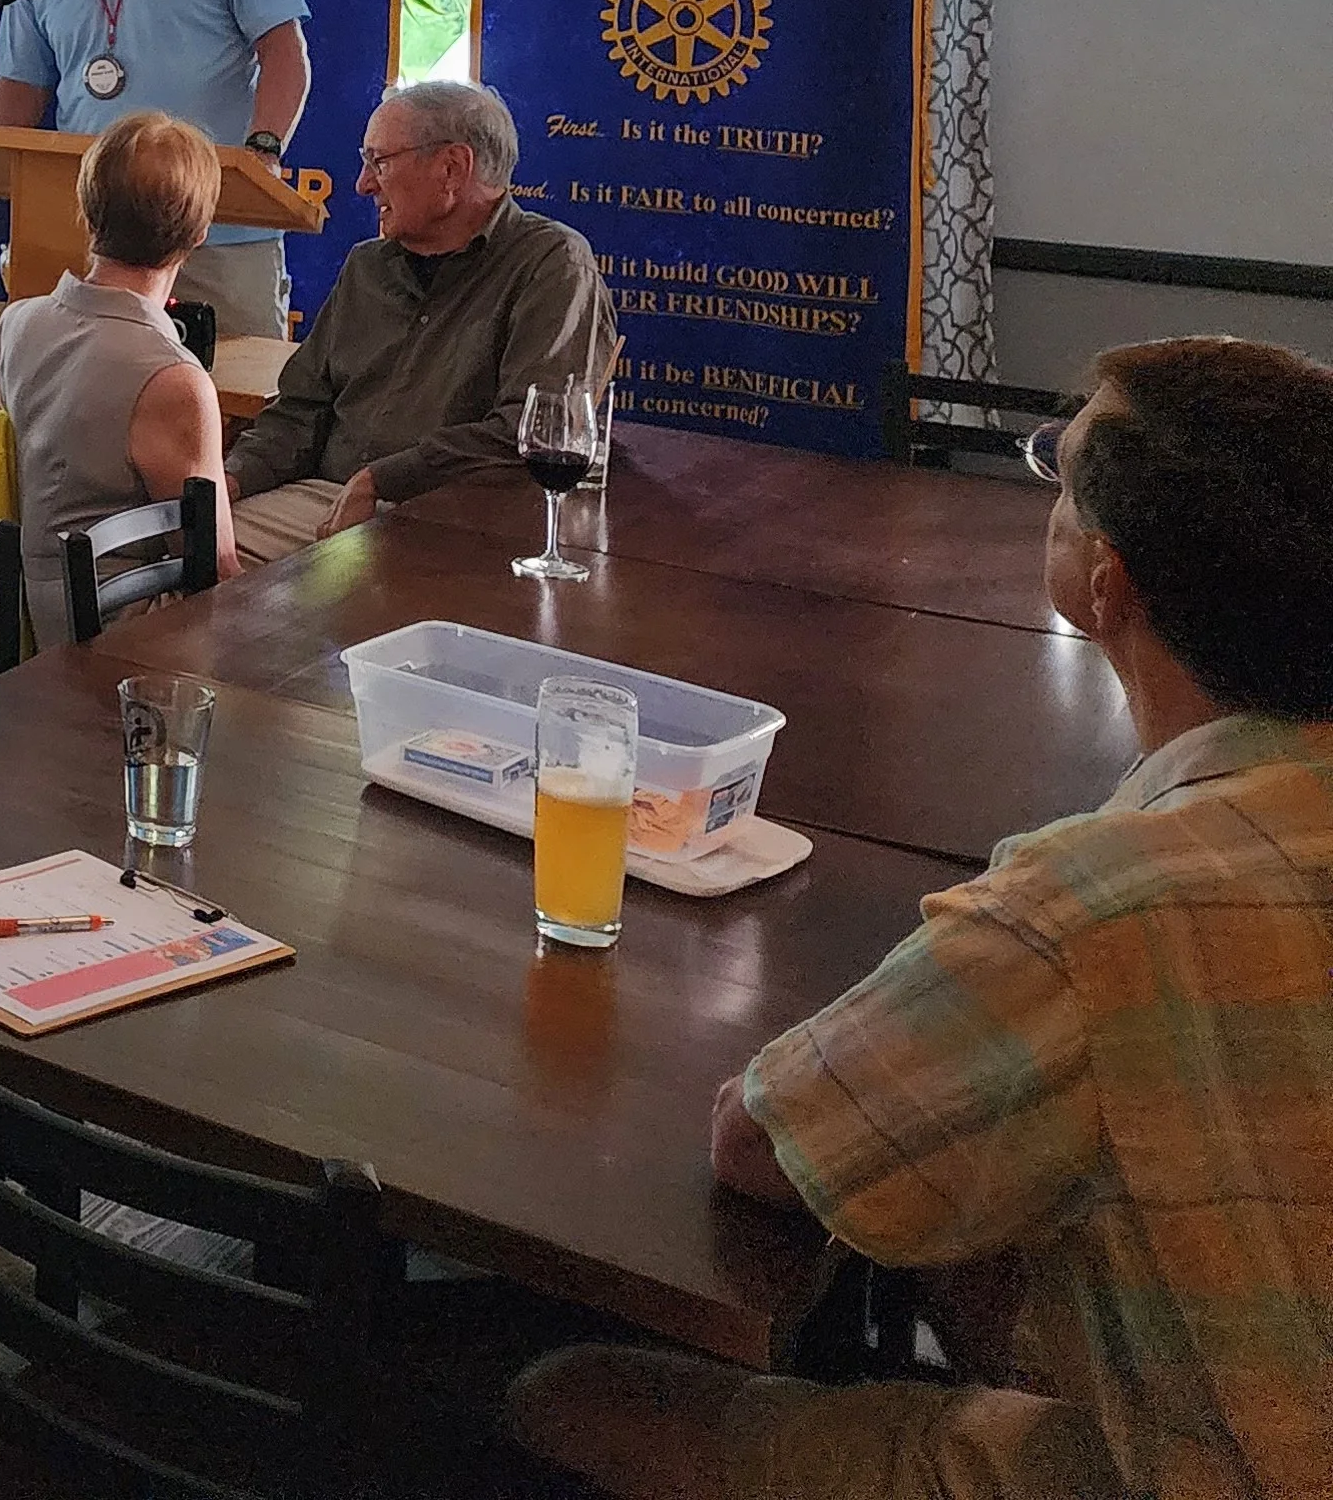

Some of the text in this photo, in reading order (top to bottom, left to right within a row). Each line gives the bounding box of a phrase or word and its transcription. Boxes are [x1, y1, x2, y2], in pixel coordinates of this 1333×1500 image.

[626, 40, 747, 86] INTERNATIONAL
[621, 118, 642, 140] Is
[648, 120, 665, 141] it
[674, 122, 710, 146] the
[718, 125, 824, 156] TRUTH?
[569, 180, 591, 202] Is
[596, 182, 612, 204] it
[620, 184, 685, 211] FAIR
[693, 191, 717, 213] to
[724, 195, 751, 217] all
[757, 202, 895, 231] concerned?
[621, 255, 636, 277] it
[645, 258, 708, 283] build
[716, 265, 789, 293] GOOD
[796, 271, 879, 300] WILL
[668, 291, 862, 335] FRIENDSHIPS?
[640, 360, 656, 381] it
[665, 362, 695, 385] be
[703, 364, 865, 407] BENEFICIAL
[642, 395, 770, 429] concerned?
